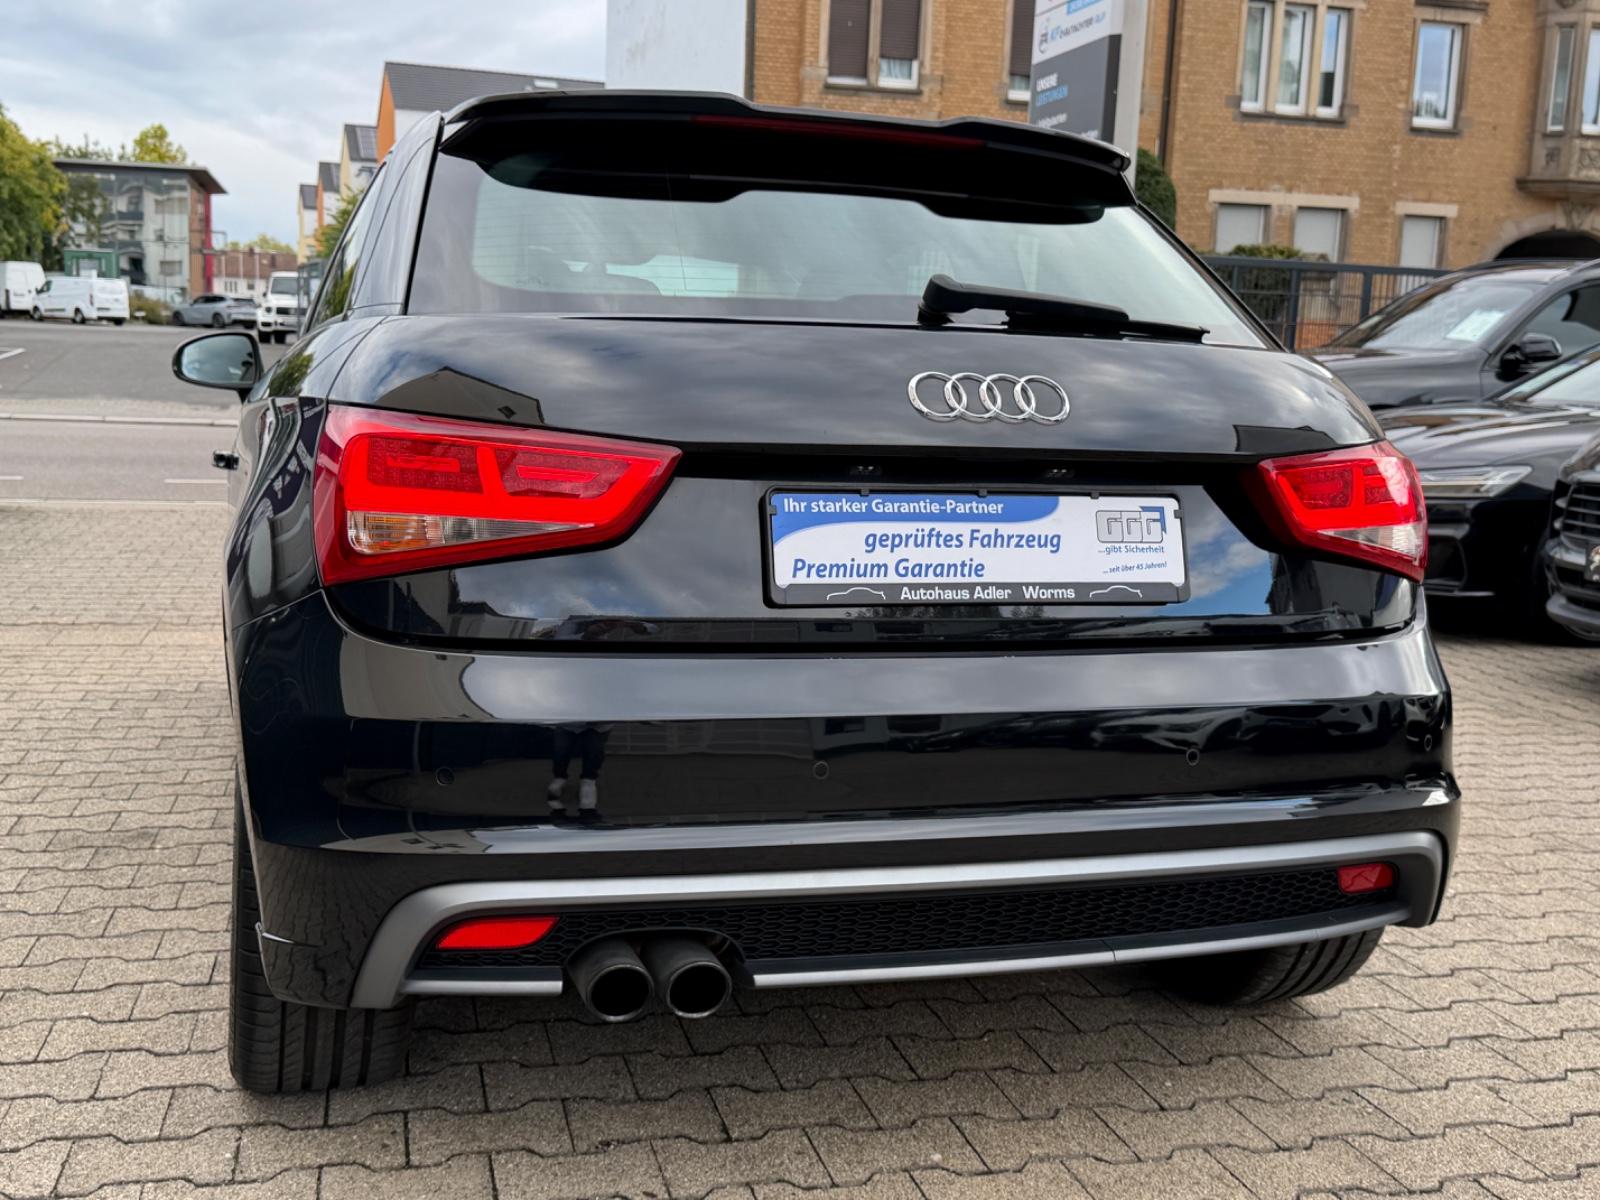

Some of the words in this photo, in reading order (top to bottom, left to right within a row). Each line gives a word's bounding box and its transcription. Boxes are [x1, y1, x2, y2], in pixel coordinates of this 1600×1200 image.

[783, 498, 808, 514] Ihr
[811, 500, 869, 515] starker
[871, 499, 1004, 516] Garantie-Partner
[864, 528, 964, 553] geprüftes
[968, 529, 1062, 553] Fahrzeug
[1124, 545, 1165, 553] Sicherheit
[792, 559, 888, 579] Premium
[894, 558, 985, 579] Garantie
[900, 586, 971, 601] Autohaus
[974, 586, 1012, 601] Adler
[1022, 586, 1076, 600] Worms
